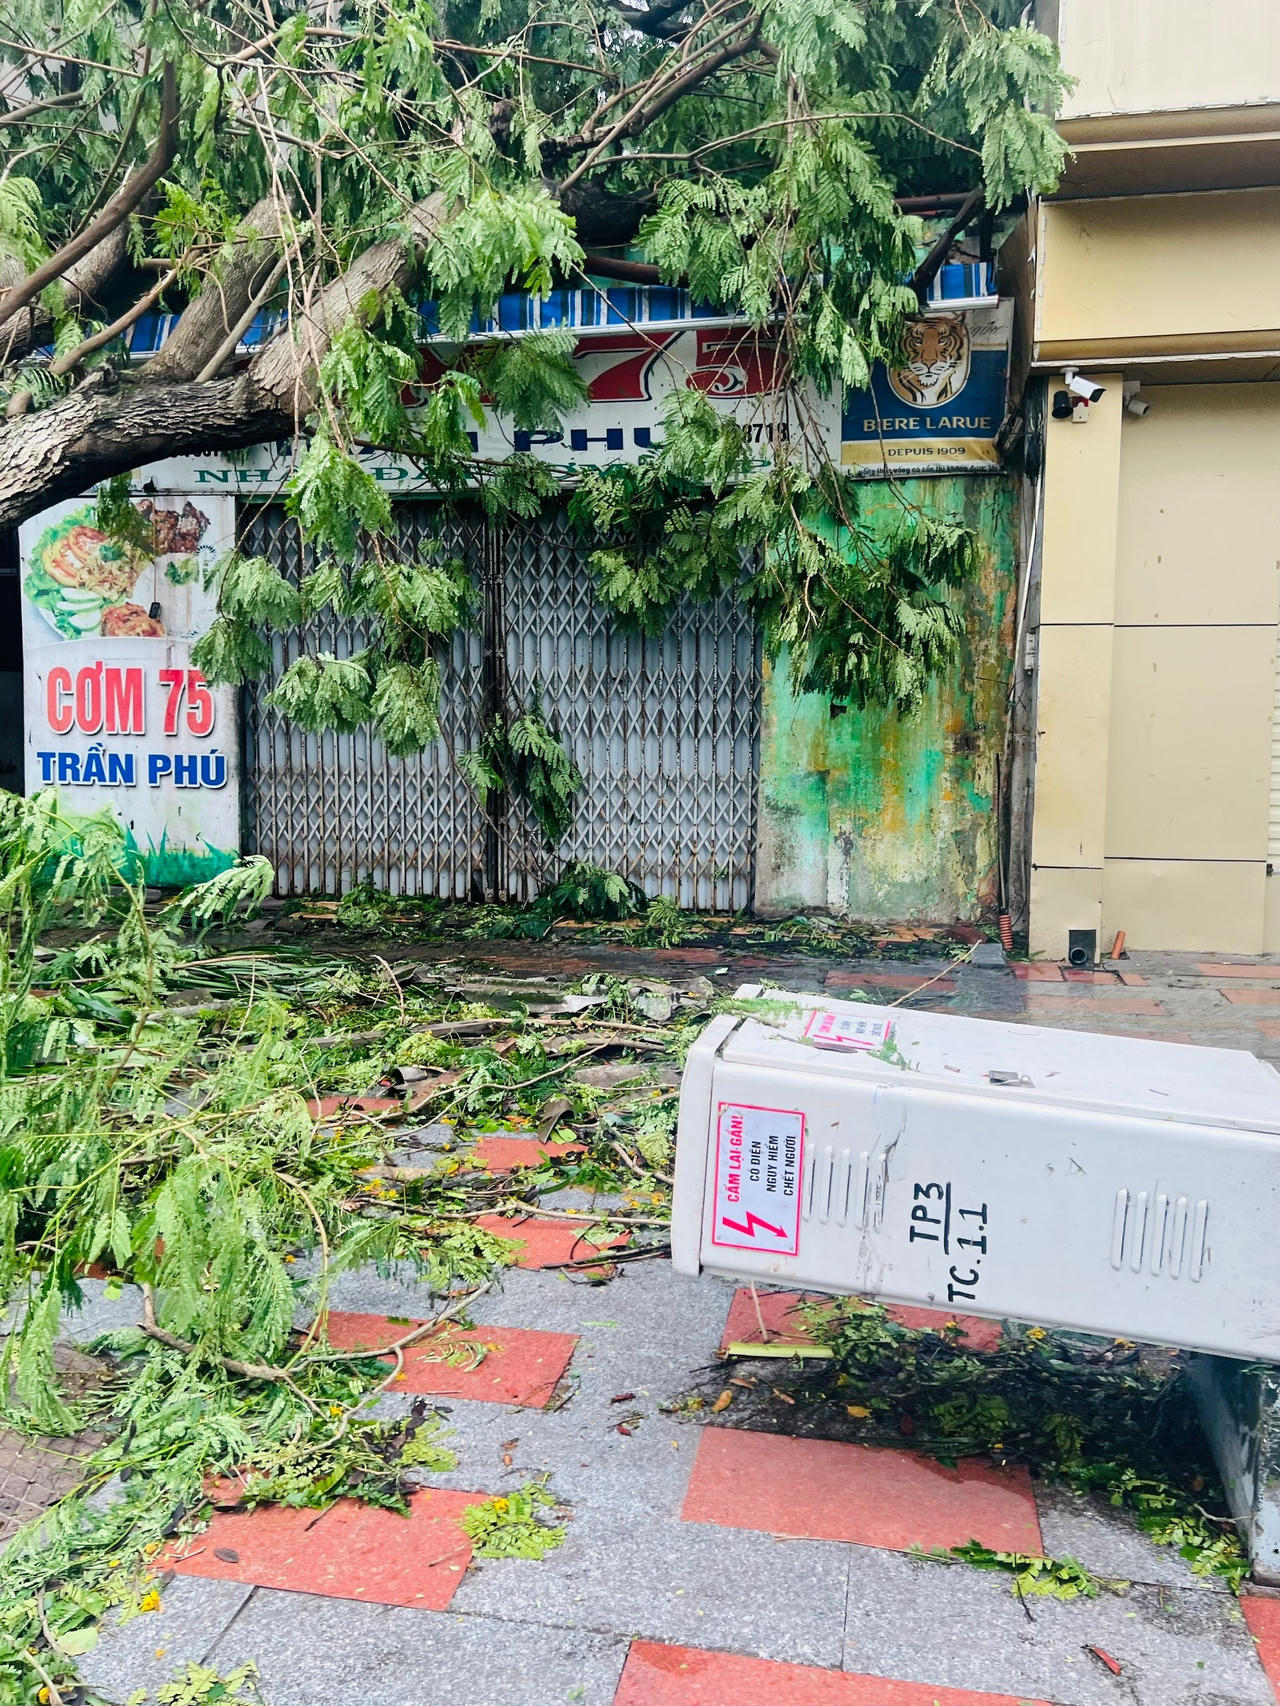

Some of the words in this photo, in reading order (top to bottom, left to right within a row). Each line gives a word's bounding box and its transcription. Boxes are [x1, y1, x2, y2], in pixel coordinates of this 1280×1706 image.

[572, 329, 790, 404] 75
[926, 416, 992, 429] LARUE
[888, 447, 934, 457] DEPUIS
[937, 446, 966, 455] 1909
[47, 661, 144, 733] CƠM
[159, 668, 214, 735] 75
[37, 742, 134, 784] TRẦN
[148, 748, 226, 787] PHÚ
[729, 1150, 744, 1171] LẠI
[748, 1141, 763, 1167] ĐIỆN
[764, 1135, 779, 1162] HIỂM
[782, 1135, 796, 1166] NGƯỜI
[723, 1173, 742, 1203] CẤM
[748, 1169, 760, 1182] CÓ
[766, 1165, 777, 1192] NGUY
[781, 1170, 795, 1196] CHẾT
[909, 1183, 944, 1242] TP3
